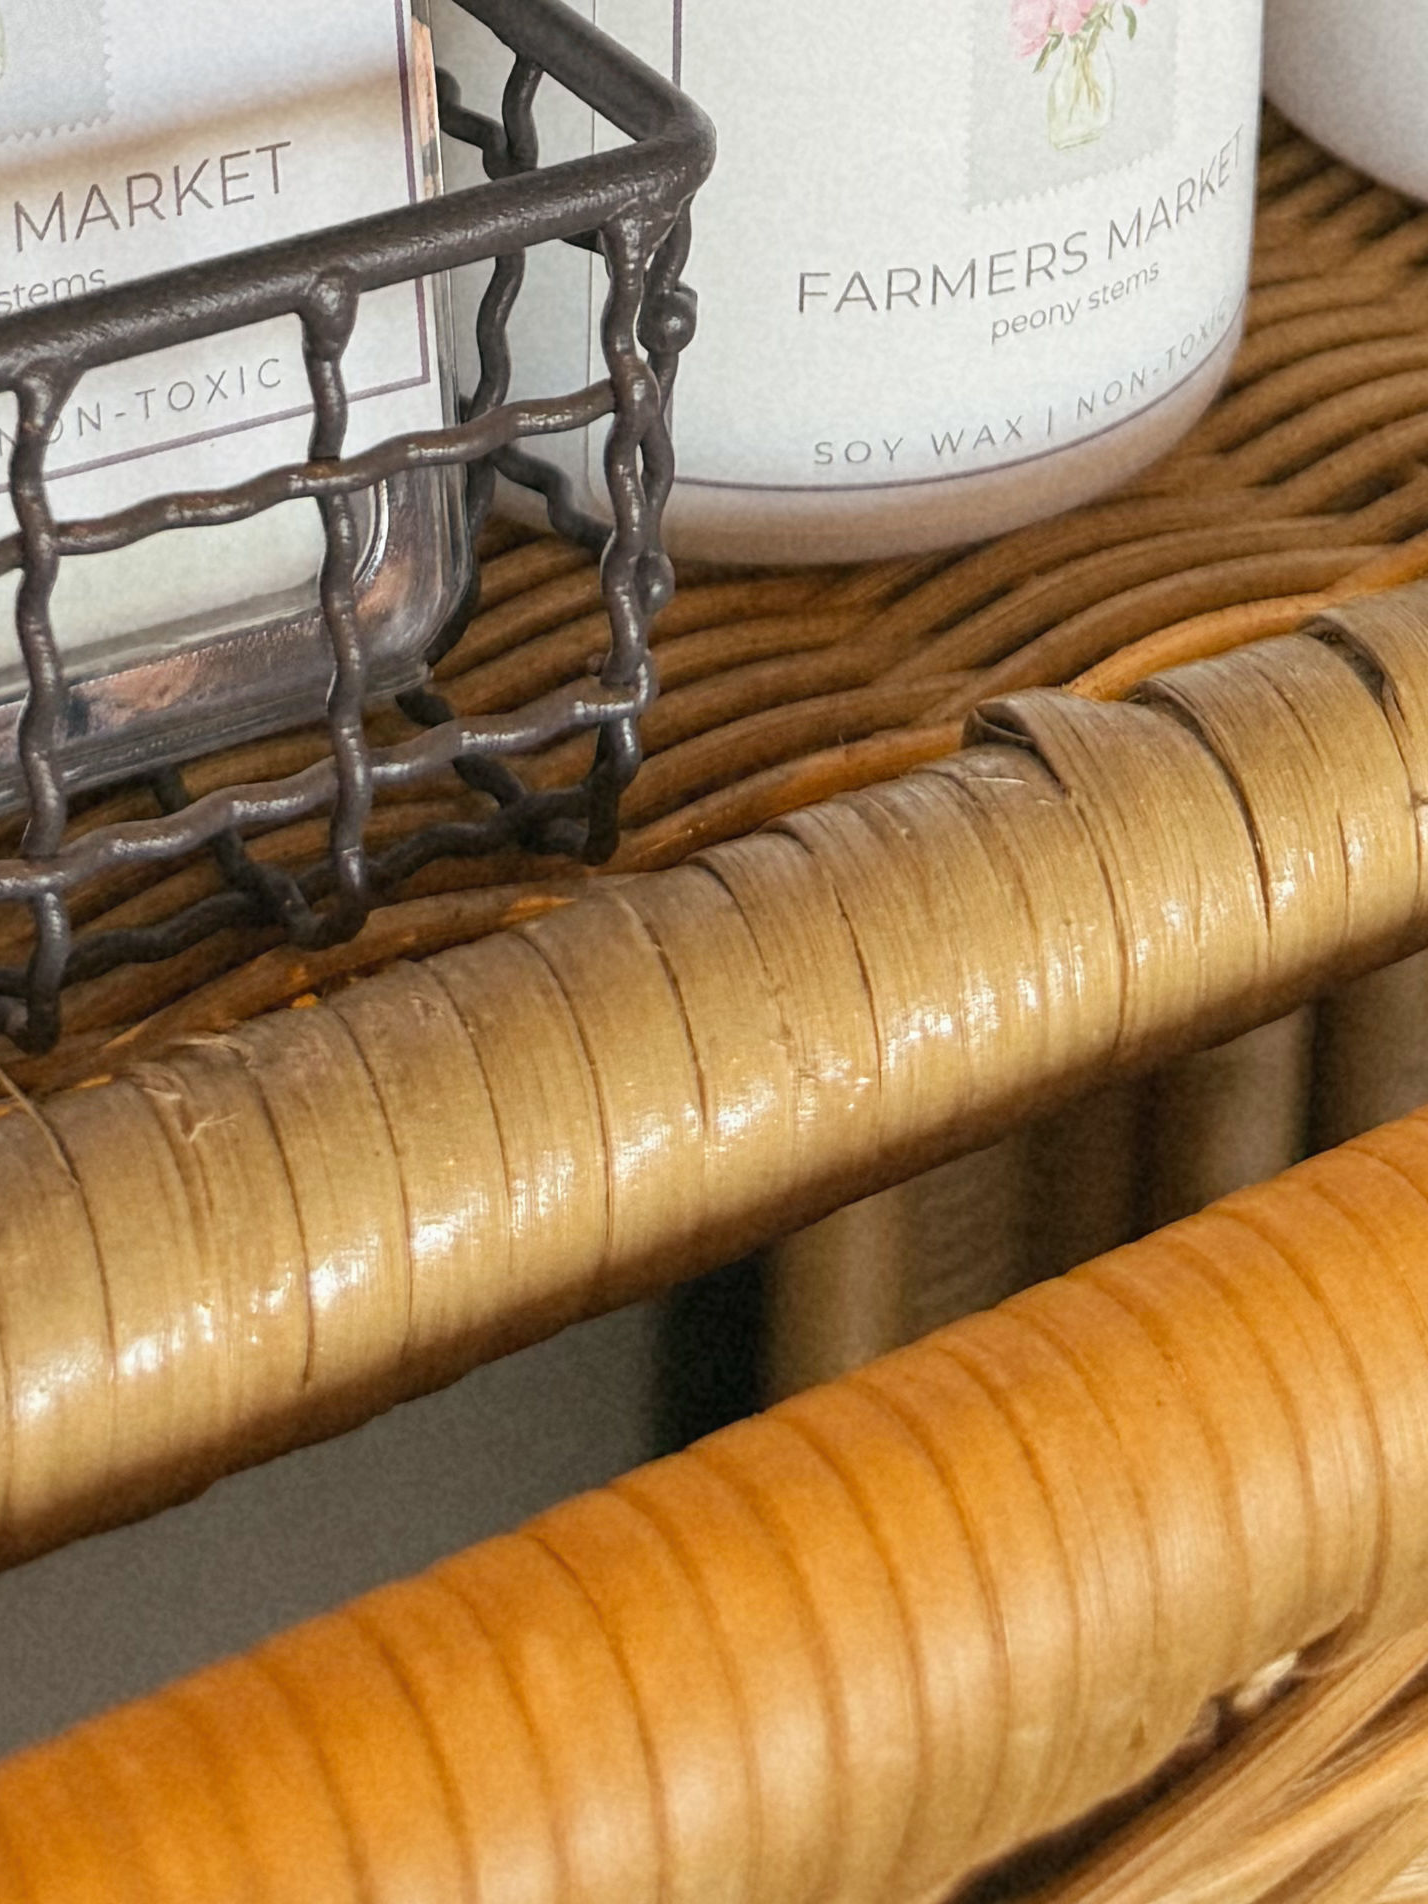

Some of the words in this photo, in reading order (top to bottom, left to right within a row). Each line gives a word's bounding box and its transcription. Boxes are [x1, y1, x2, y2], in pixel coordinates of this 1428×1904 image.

[13, 140, 293, 254] MARKET
[797, 230, 1089, 314] FARMERS
[1106, 123, 1245, 260] MARKET
[990, 297, 1083, 345] peony
[1087, 261, 1160, 311] stems
[813, 436, 904, 466] SOY
[930, 414, 1023, 457] WAX
[1075, 295, 1231, 422] NON-TOXIC
